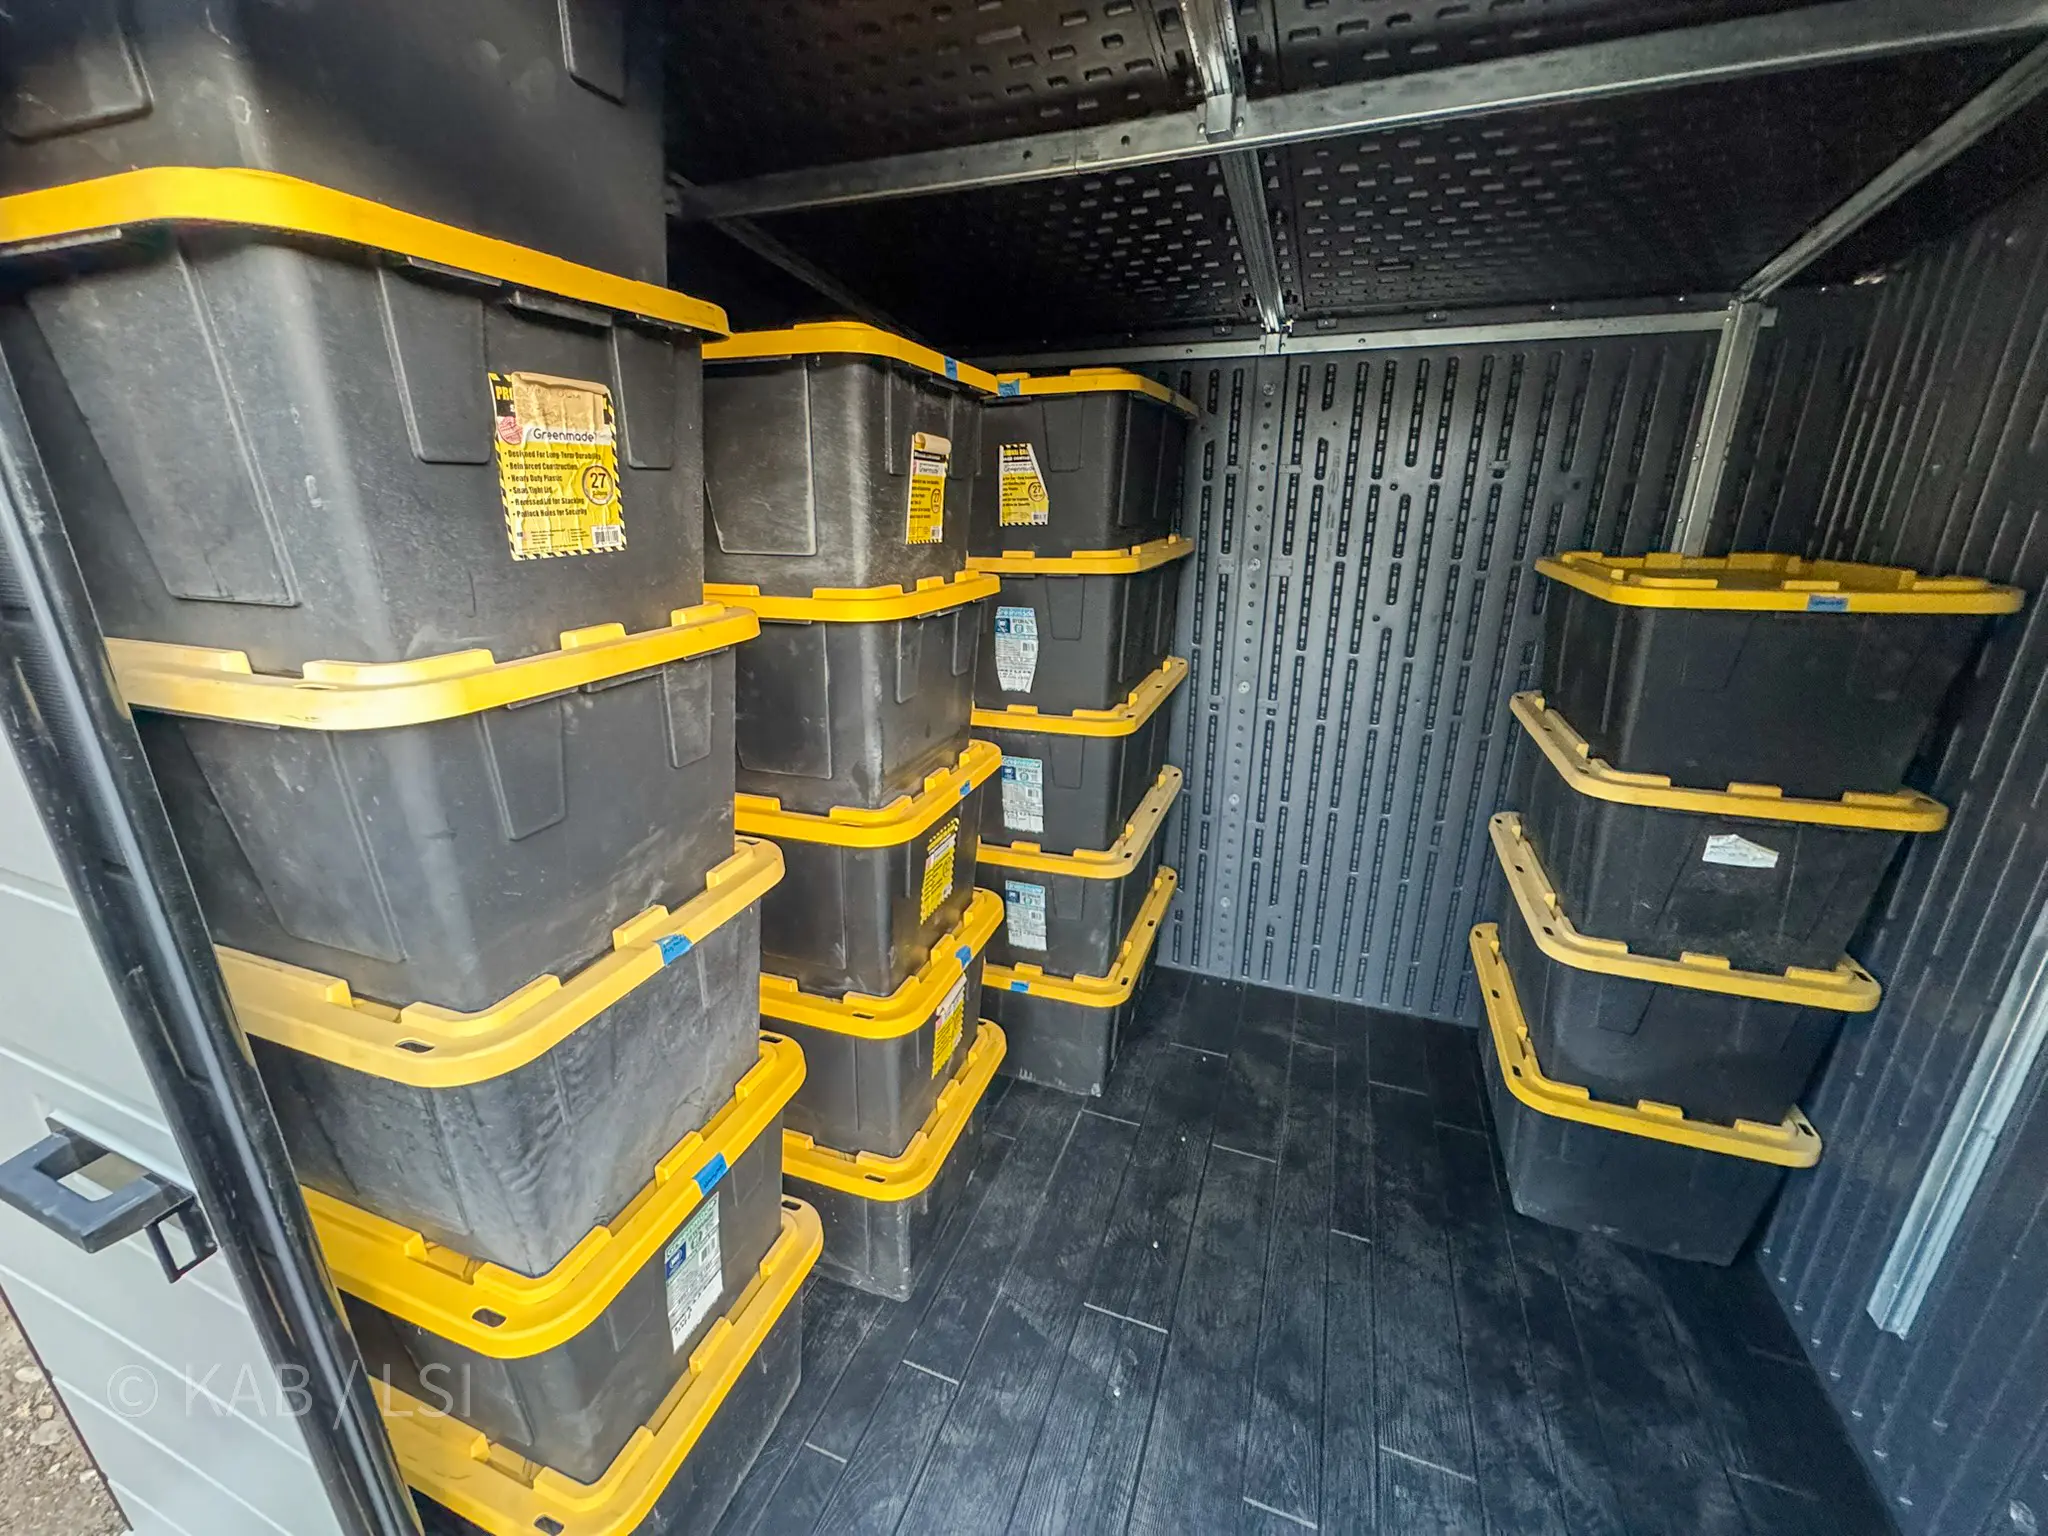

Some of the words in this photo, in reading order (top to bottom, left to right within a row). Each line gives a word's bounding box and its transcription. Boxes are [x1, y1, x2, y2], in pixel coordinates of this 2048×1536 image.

[533, 428, 595, 442] Greenmade
[590, 472, 607, 489] 27
[1032, 485, 1042, 494] 27
